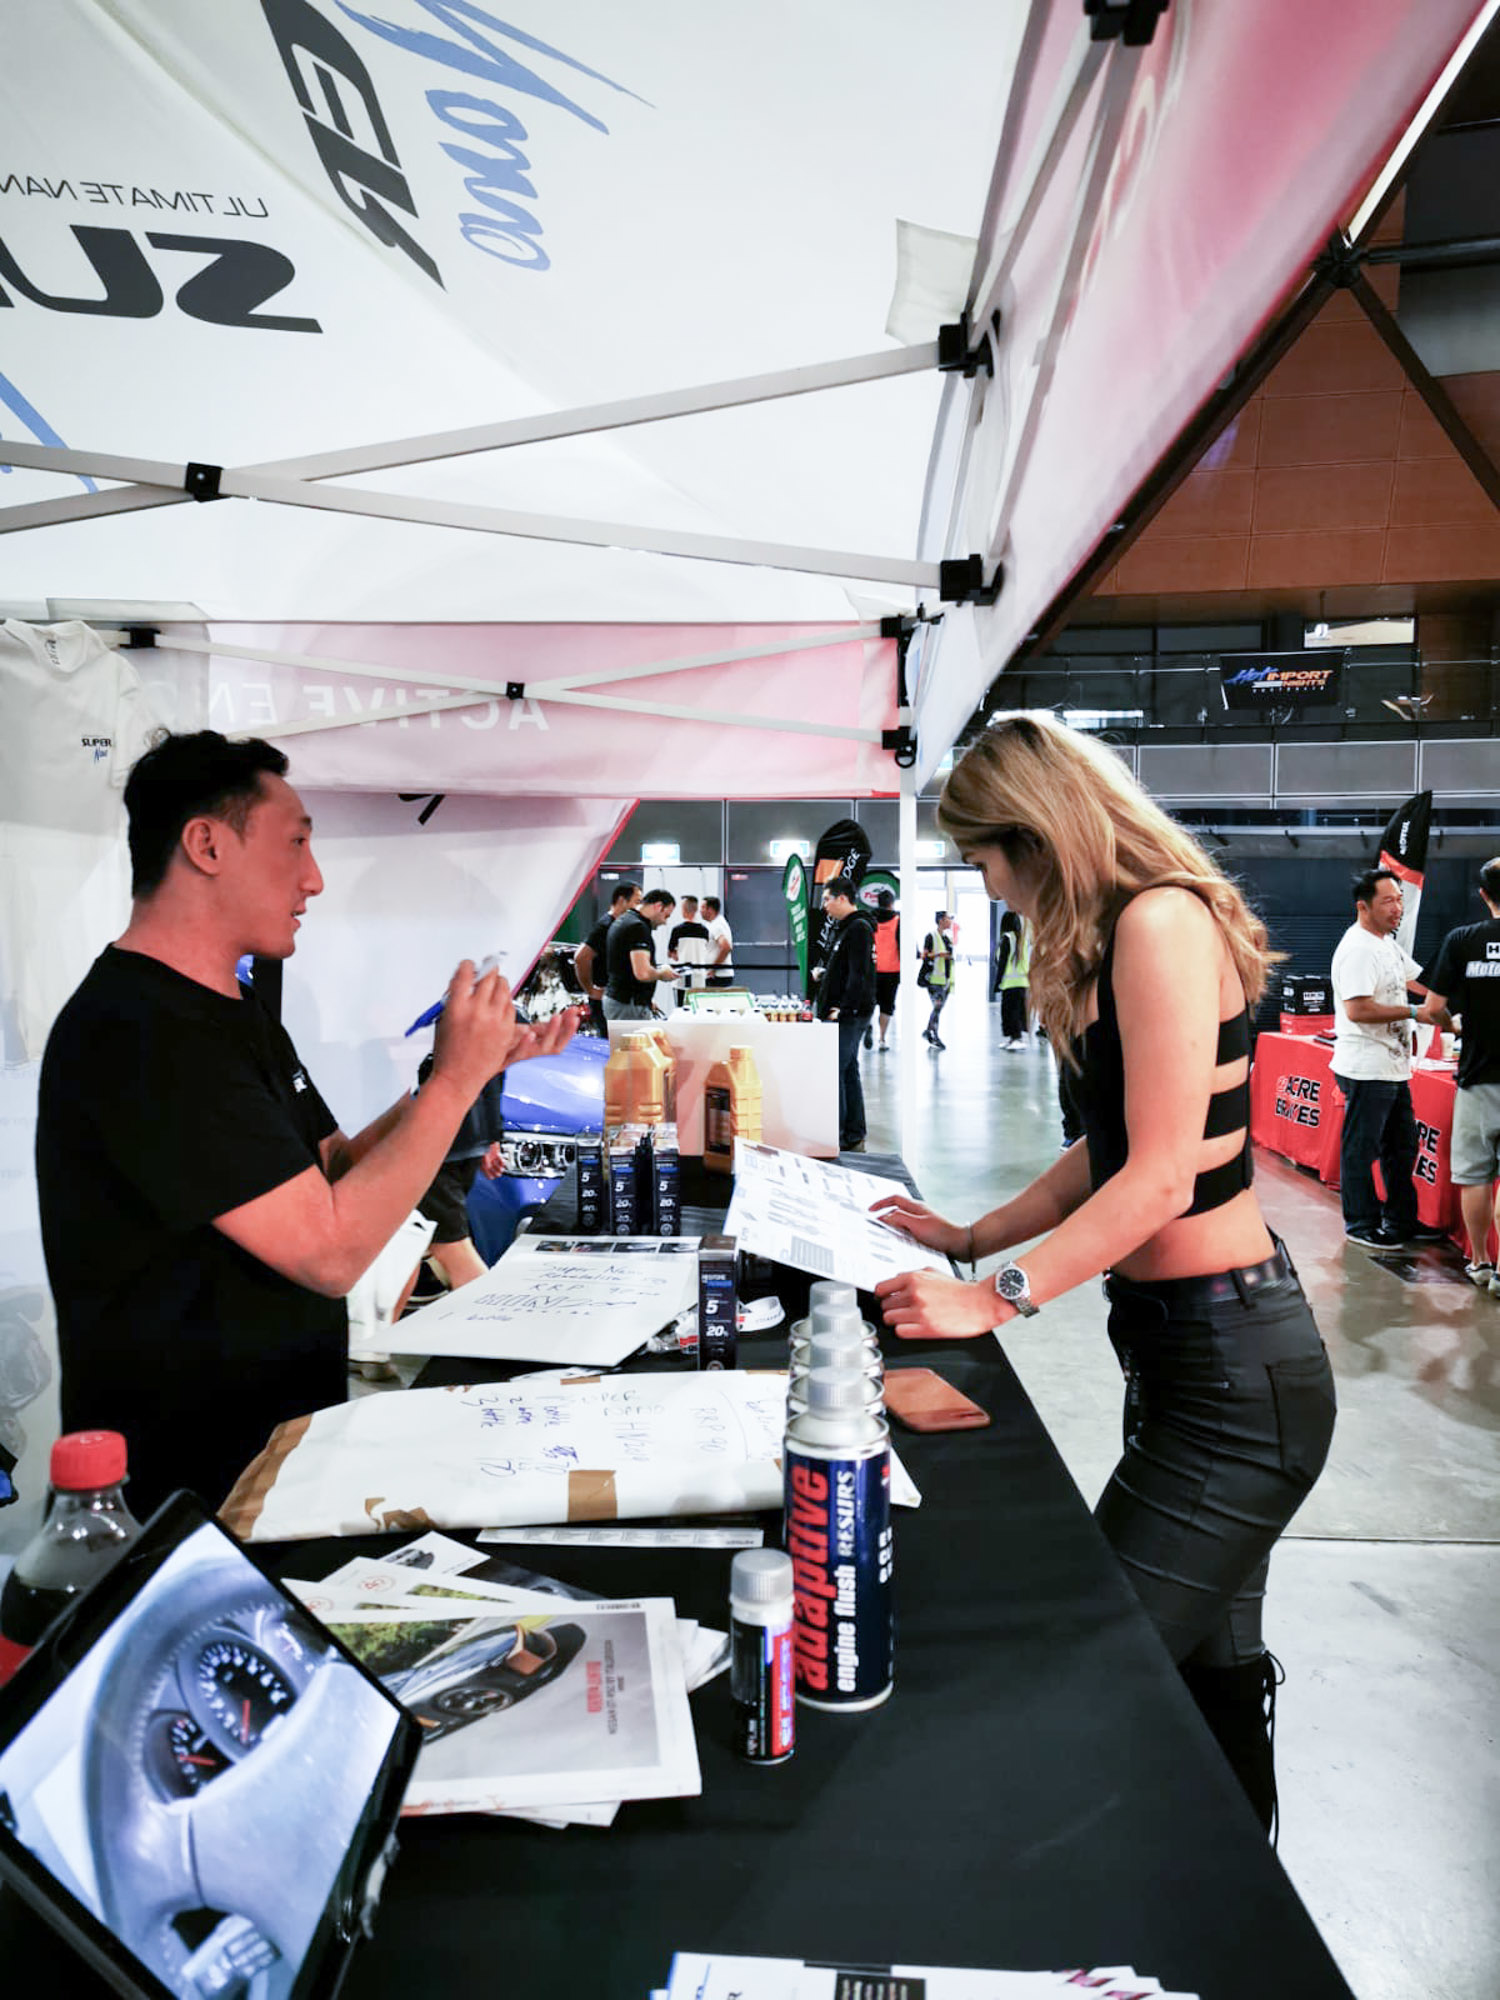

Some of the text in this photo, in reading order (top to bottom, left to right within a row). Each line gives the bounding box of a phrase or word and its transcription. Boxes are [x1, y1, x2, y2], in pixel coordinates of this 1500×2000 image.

[1265, 669, 1334, 682] IMPORT
[81, 738, 112, 747] SUPER
[1399, 820, 1411, 856] MOTUL
[581, 1171, 591, 1183] 5
[615, 1181, 625, 1193] 5
[659, 1180, 669, 1192] 5
[705, 1300, 720, 1315] 5
[833, 1470, 860, 1692] engine flush RESURS
